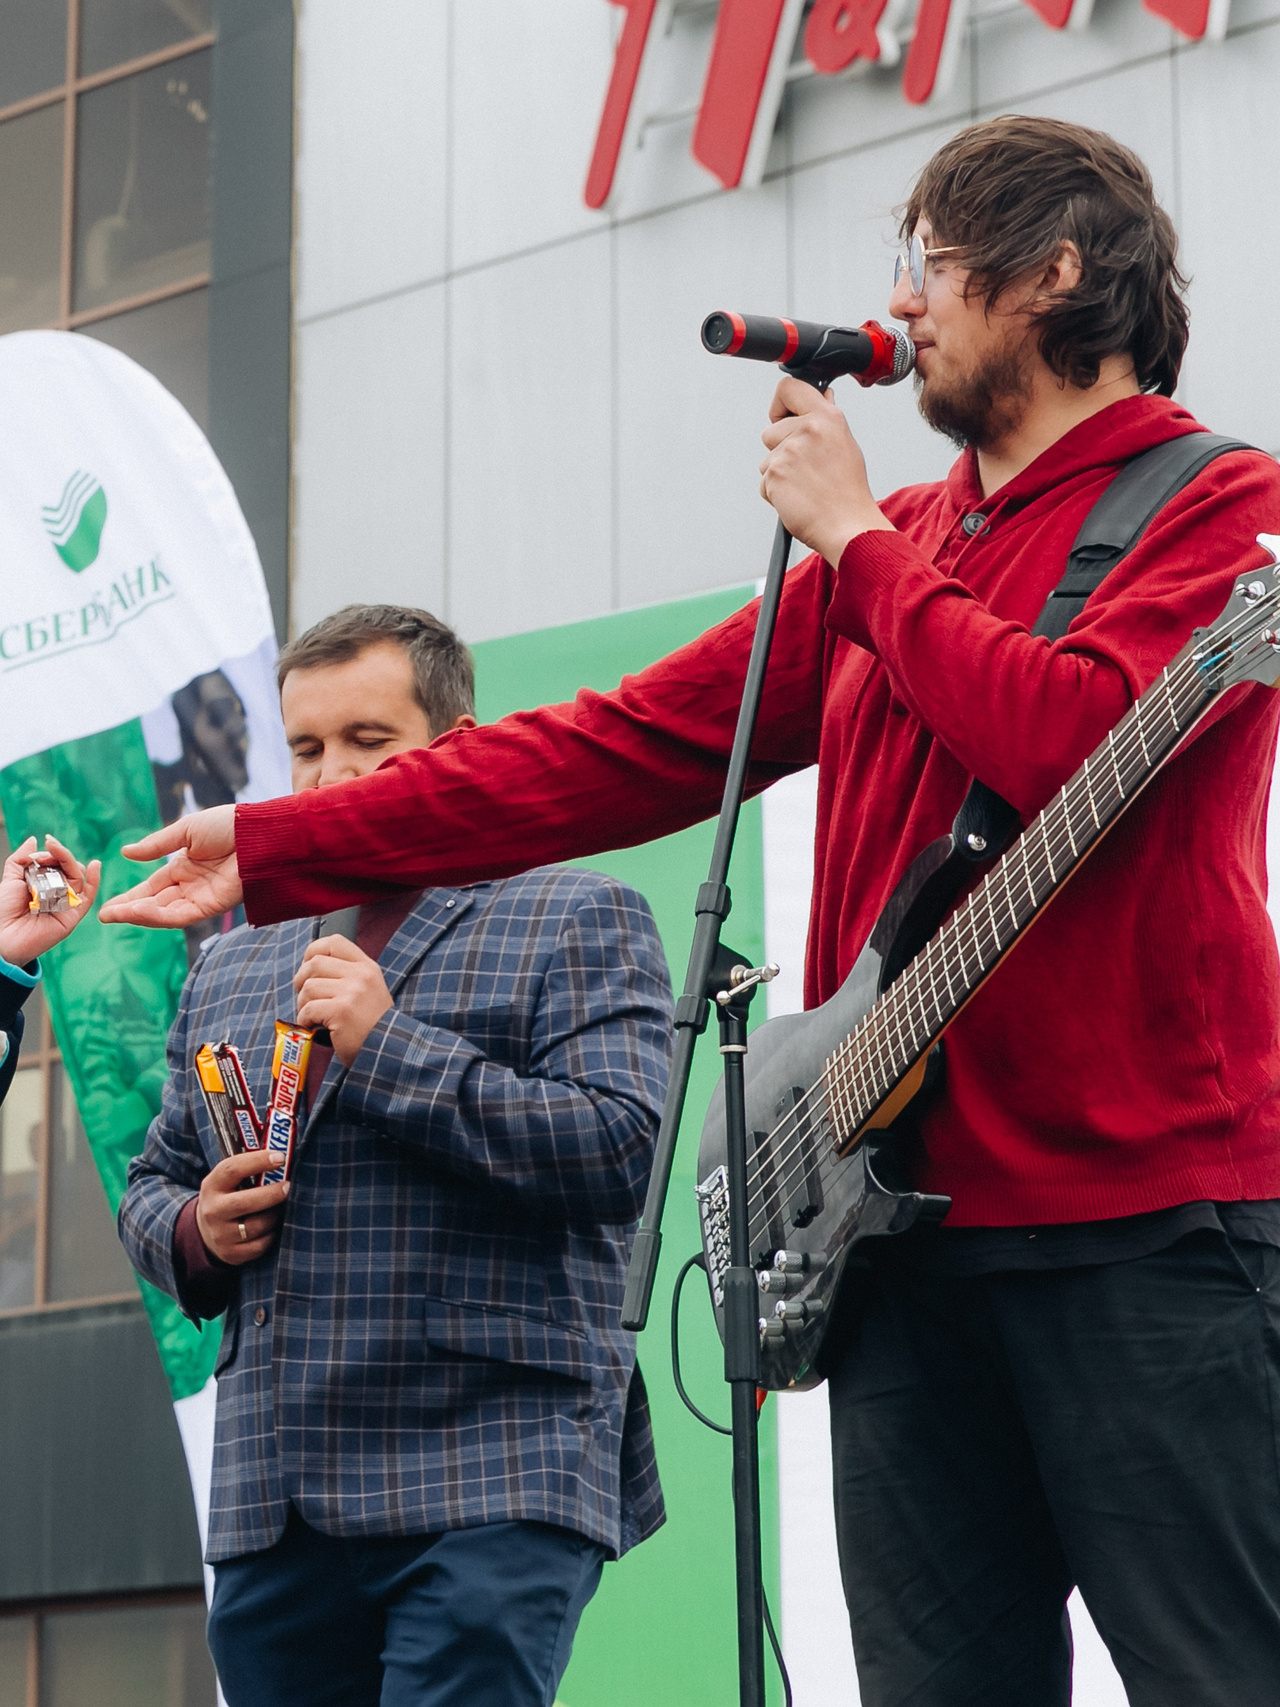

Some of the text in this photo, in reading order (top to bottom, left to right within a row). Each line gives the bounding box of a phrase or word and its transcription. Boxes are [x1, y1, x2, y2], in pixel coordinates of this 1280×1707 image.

[276, 1068, 298, 1112] SUPER
[237, 1112, 258, 1149] SNICKERS
[263, 1112, 292, 1186] NKERS
